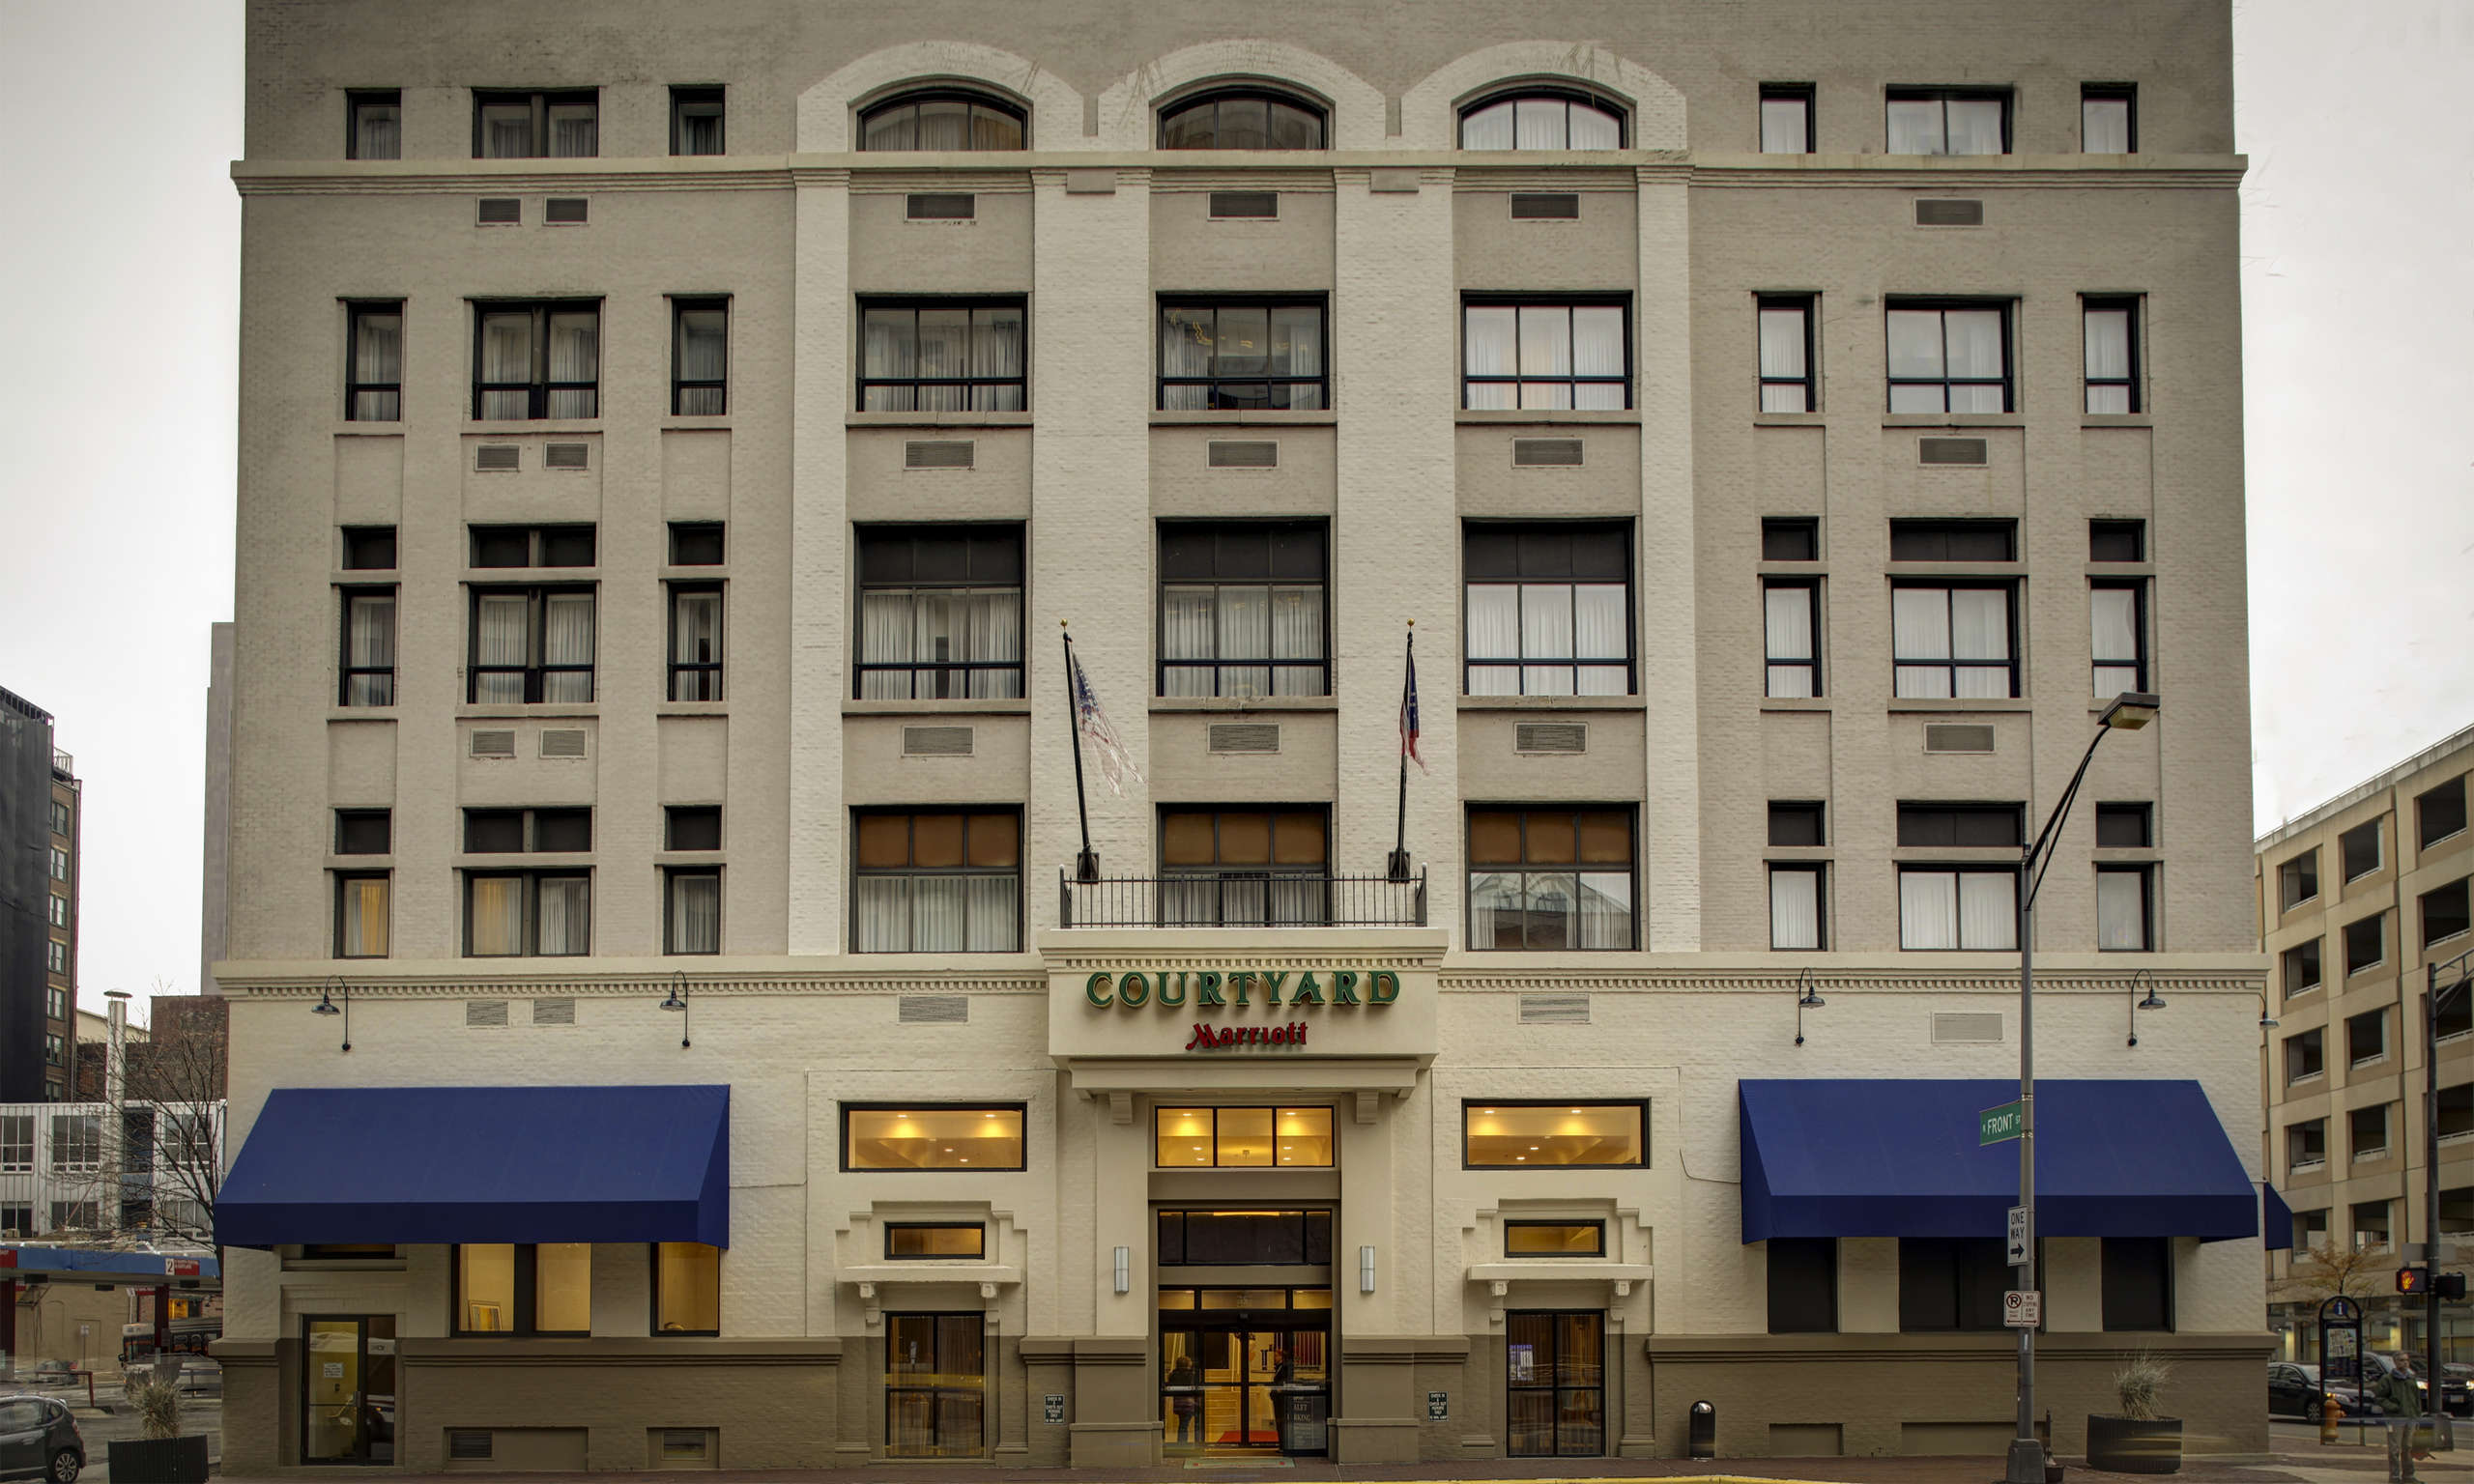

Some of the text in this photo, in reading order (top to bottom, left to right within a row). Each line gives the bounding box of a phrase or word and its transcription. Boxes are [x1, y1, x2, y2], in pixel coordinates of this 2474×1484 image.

[1085, 971, 1400, 1007] COURTYARD
[1185, 1021, 1309, 1050] Marriott
[1987, 1113, 2013, 1135] FRONT
[2010, 1211, 2025, 1225] ONE
[2010, 1227, 2025, 1240] WAY
[167, 1259, 173, 1272] 2
